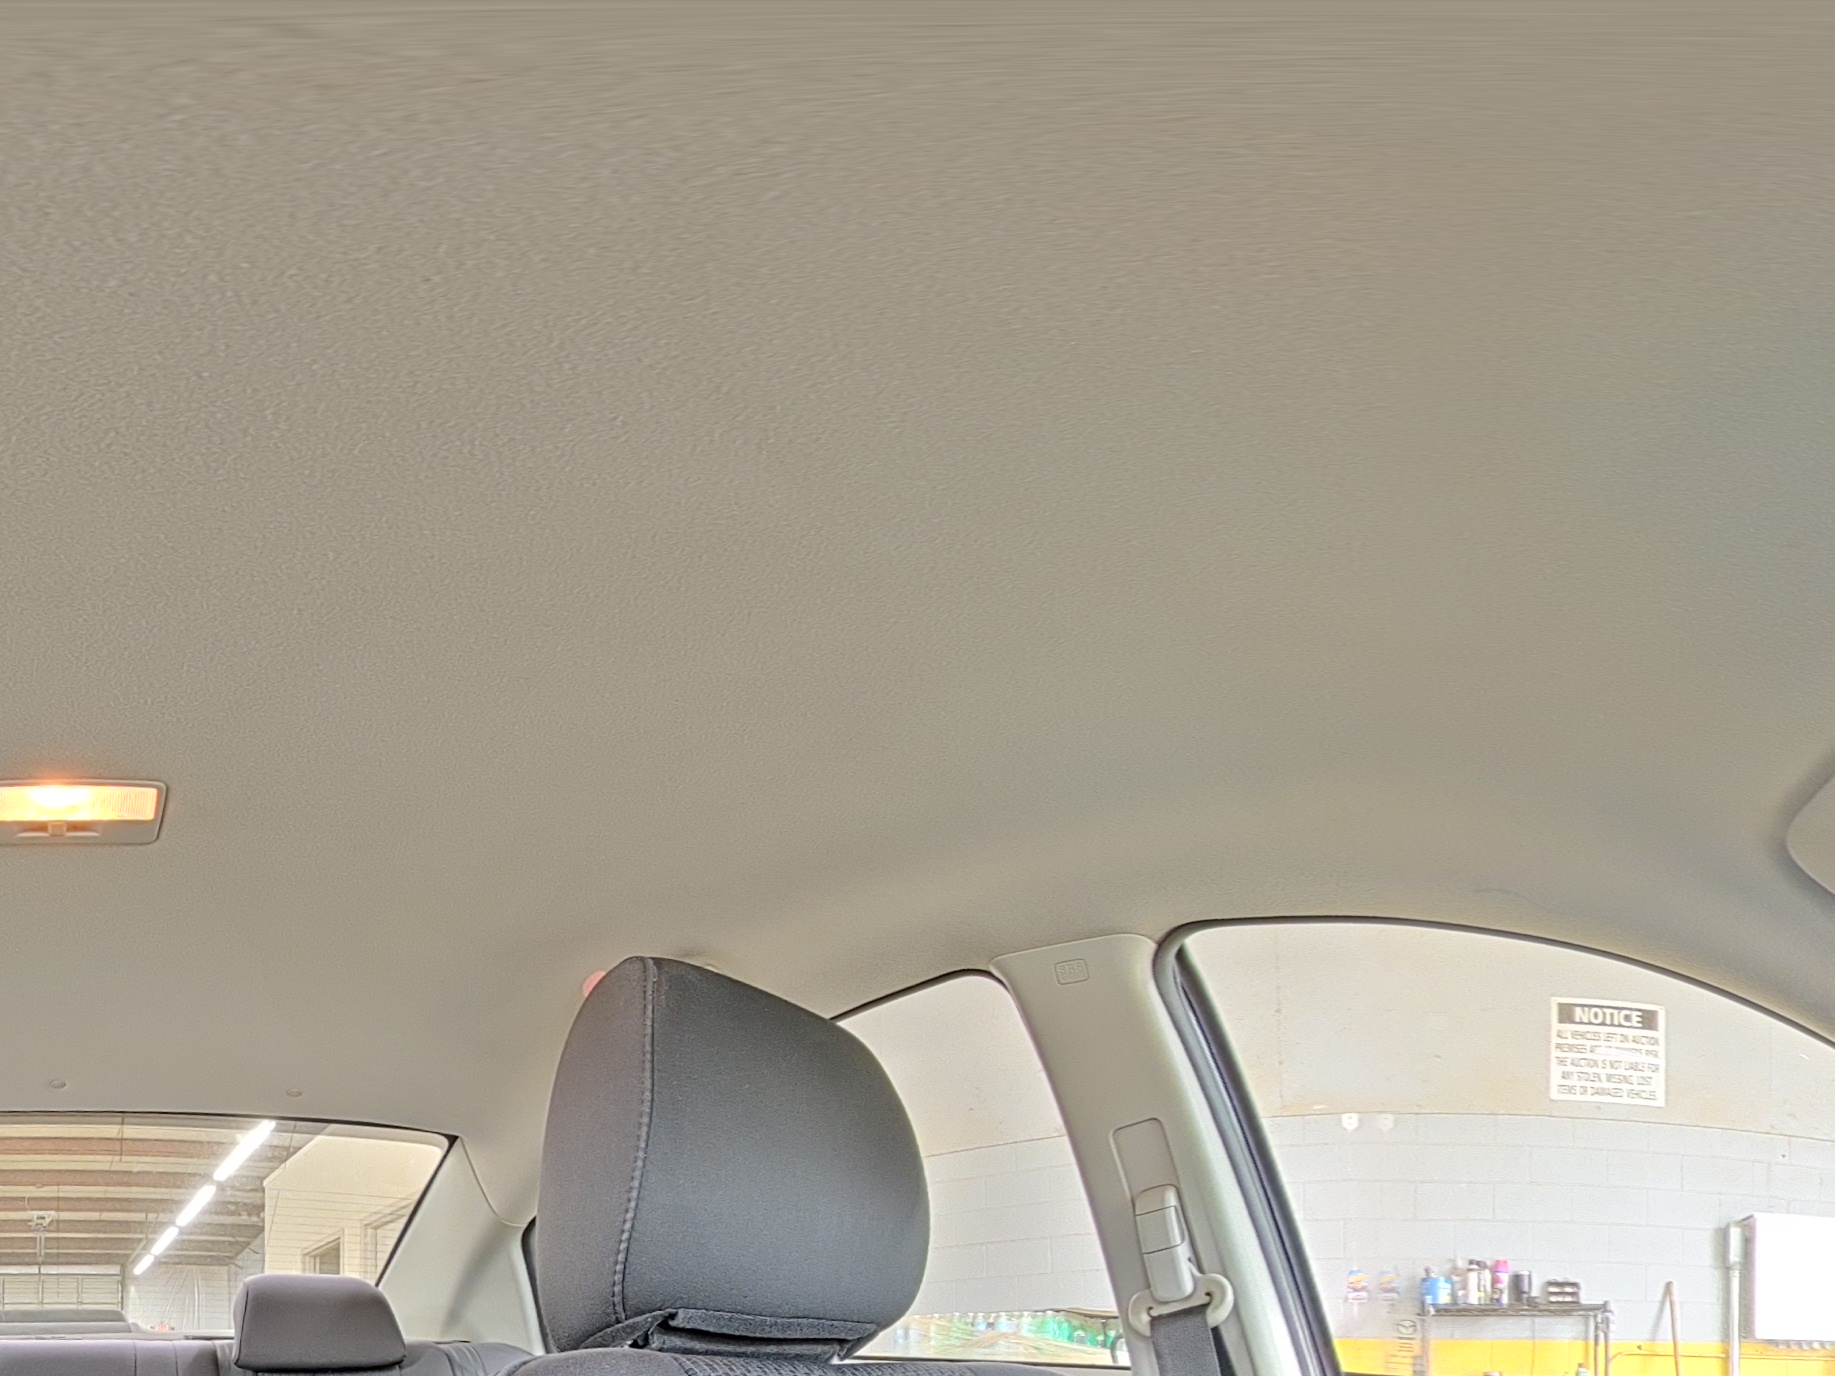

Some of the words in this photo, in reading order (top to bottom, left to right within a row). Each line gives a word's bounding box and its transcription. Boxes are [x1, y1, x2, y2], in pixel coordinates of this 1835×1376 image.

[1574, 1006, 1643, 1028] NOTICE
[1571, 1030, 1601, 1041] VEHICLES
[1632, 1034, 1660, 1046] AUCTION
[1570, 1057, 1599, 1069] AUCTION
[1609, 1060, 1623, 1070] NOT
